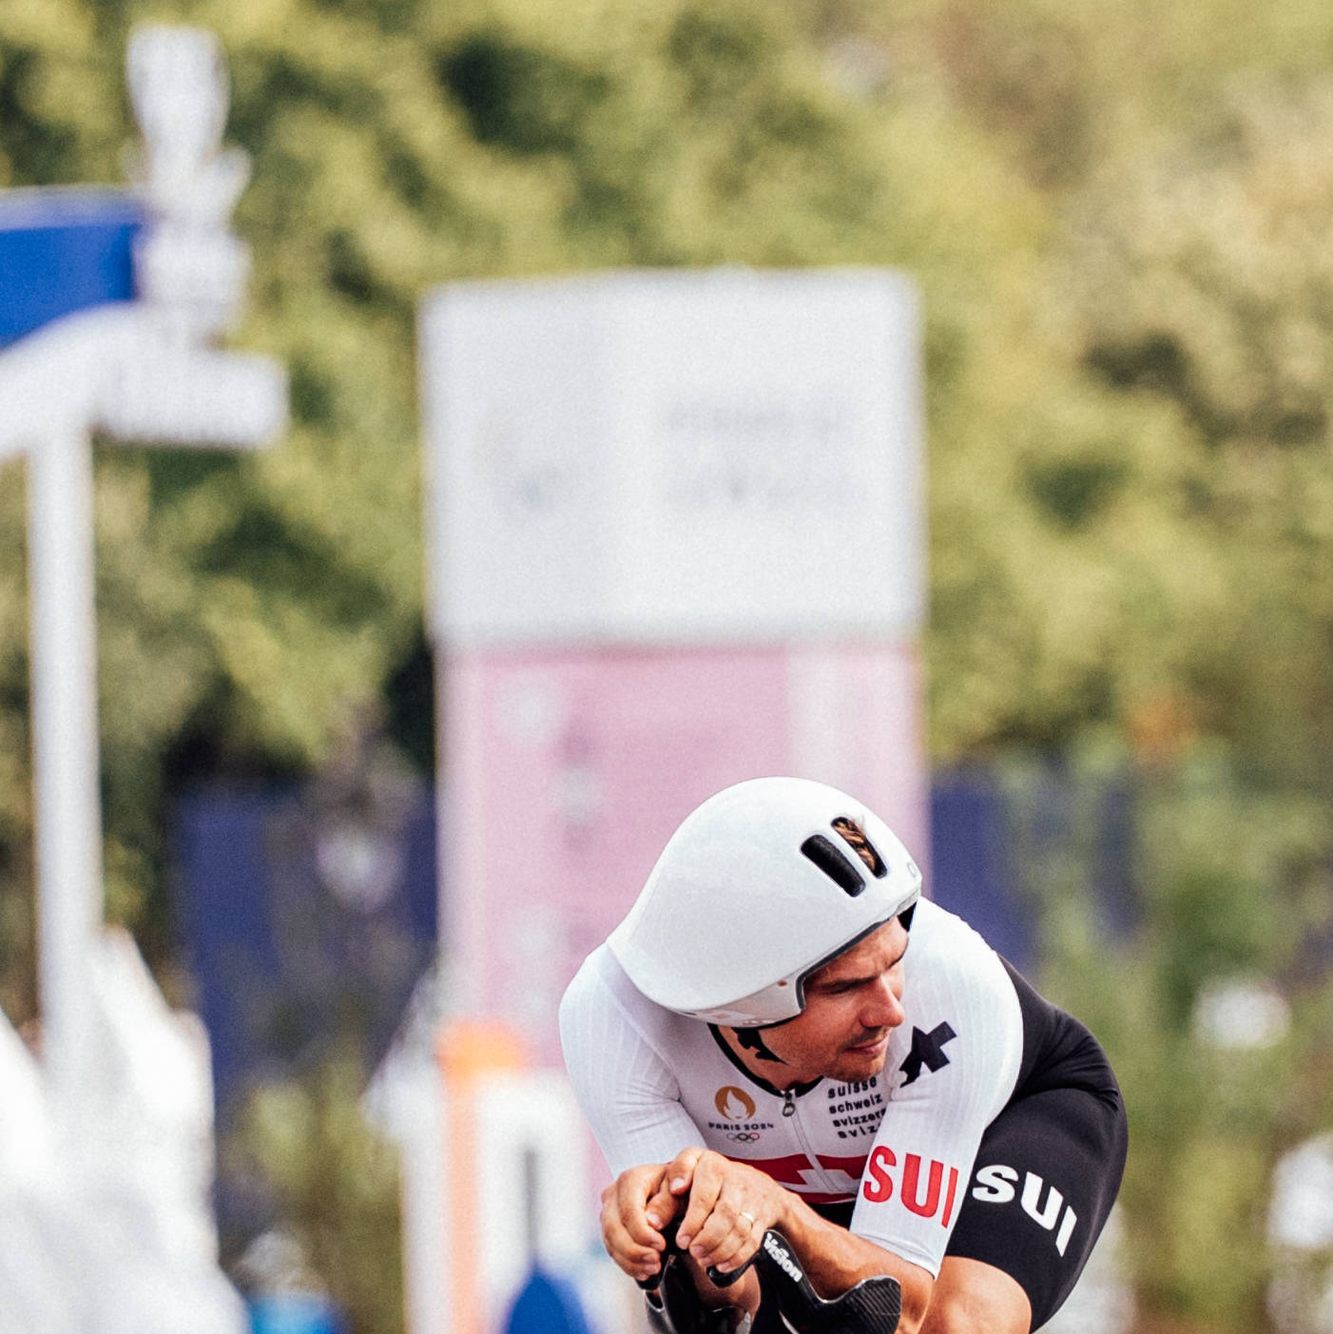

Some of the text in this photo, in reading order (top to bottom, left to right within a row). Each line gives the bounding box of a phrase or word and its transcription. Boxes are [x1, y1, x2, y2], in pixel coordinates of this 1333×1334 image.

[827, 1076, 878, 1100] suisse
[828, 1093, 884, 1115] schweiz
[708, 1121, 774, 1131] PARIS 2024
[862, 1145, 959, 1229] SUI
[971, 1164, 1078, 1258] SUI
